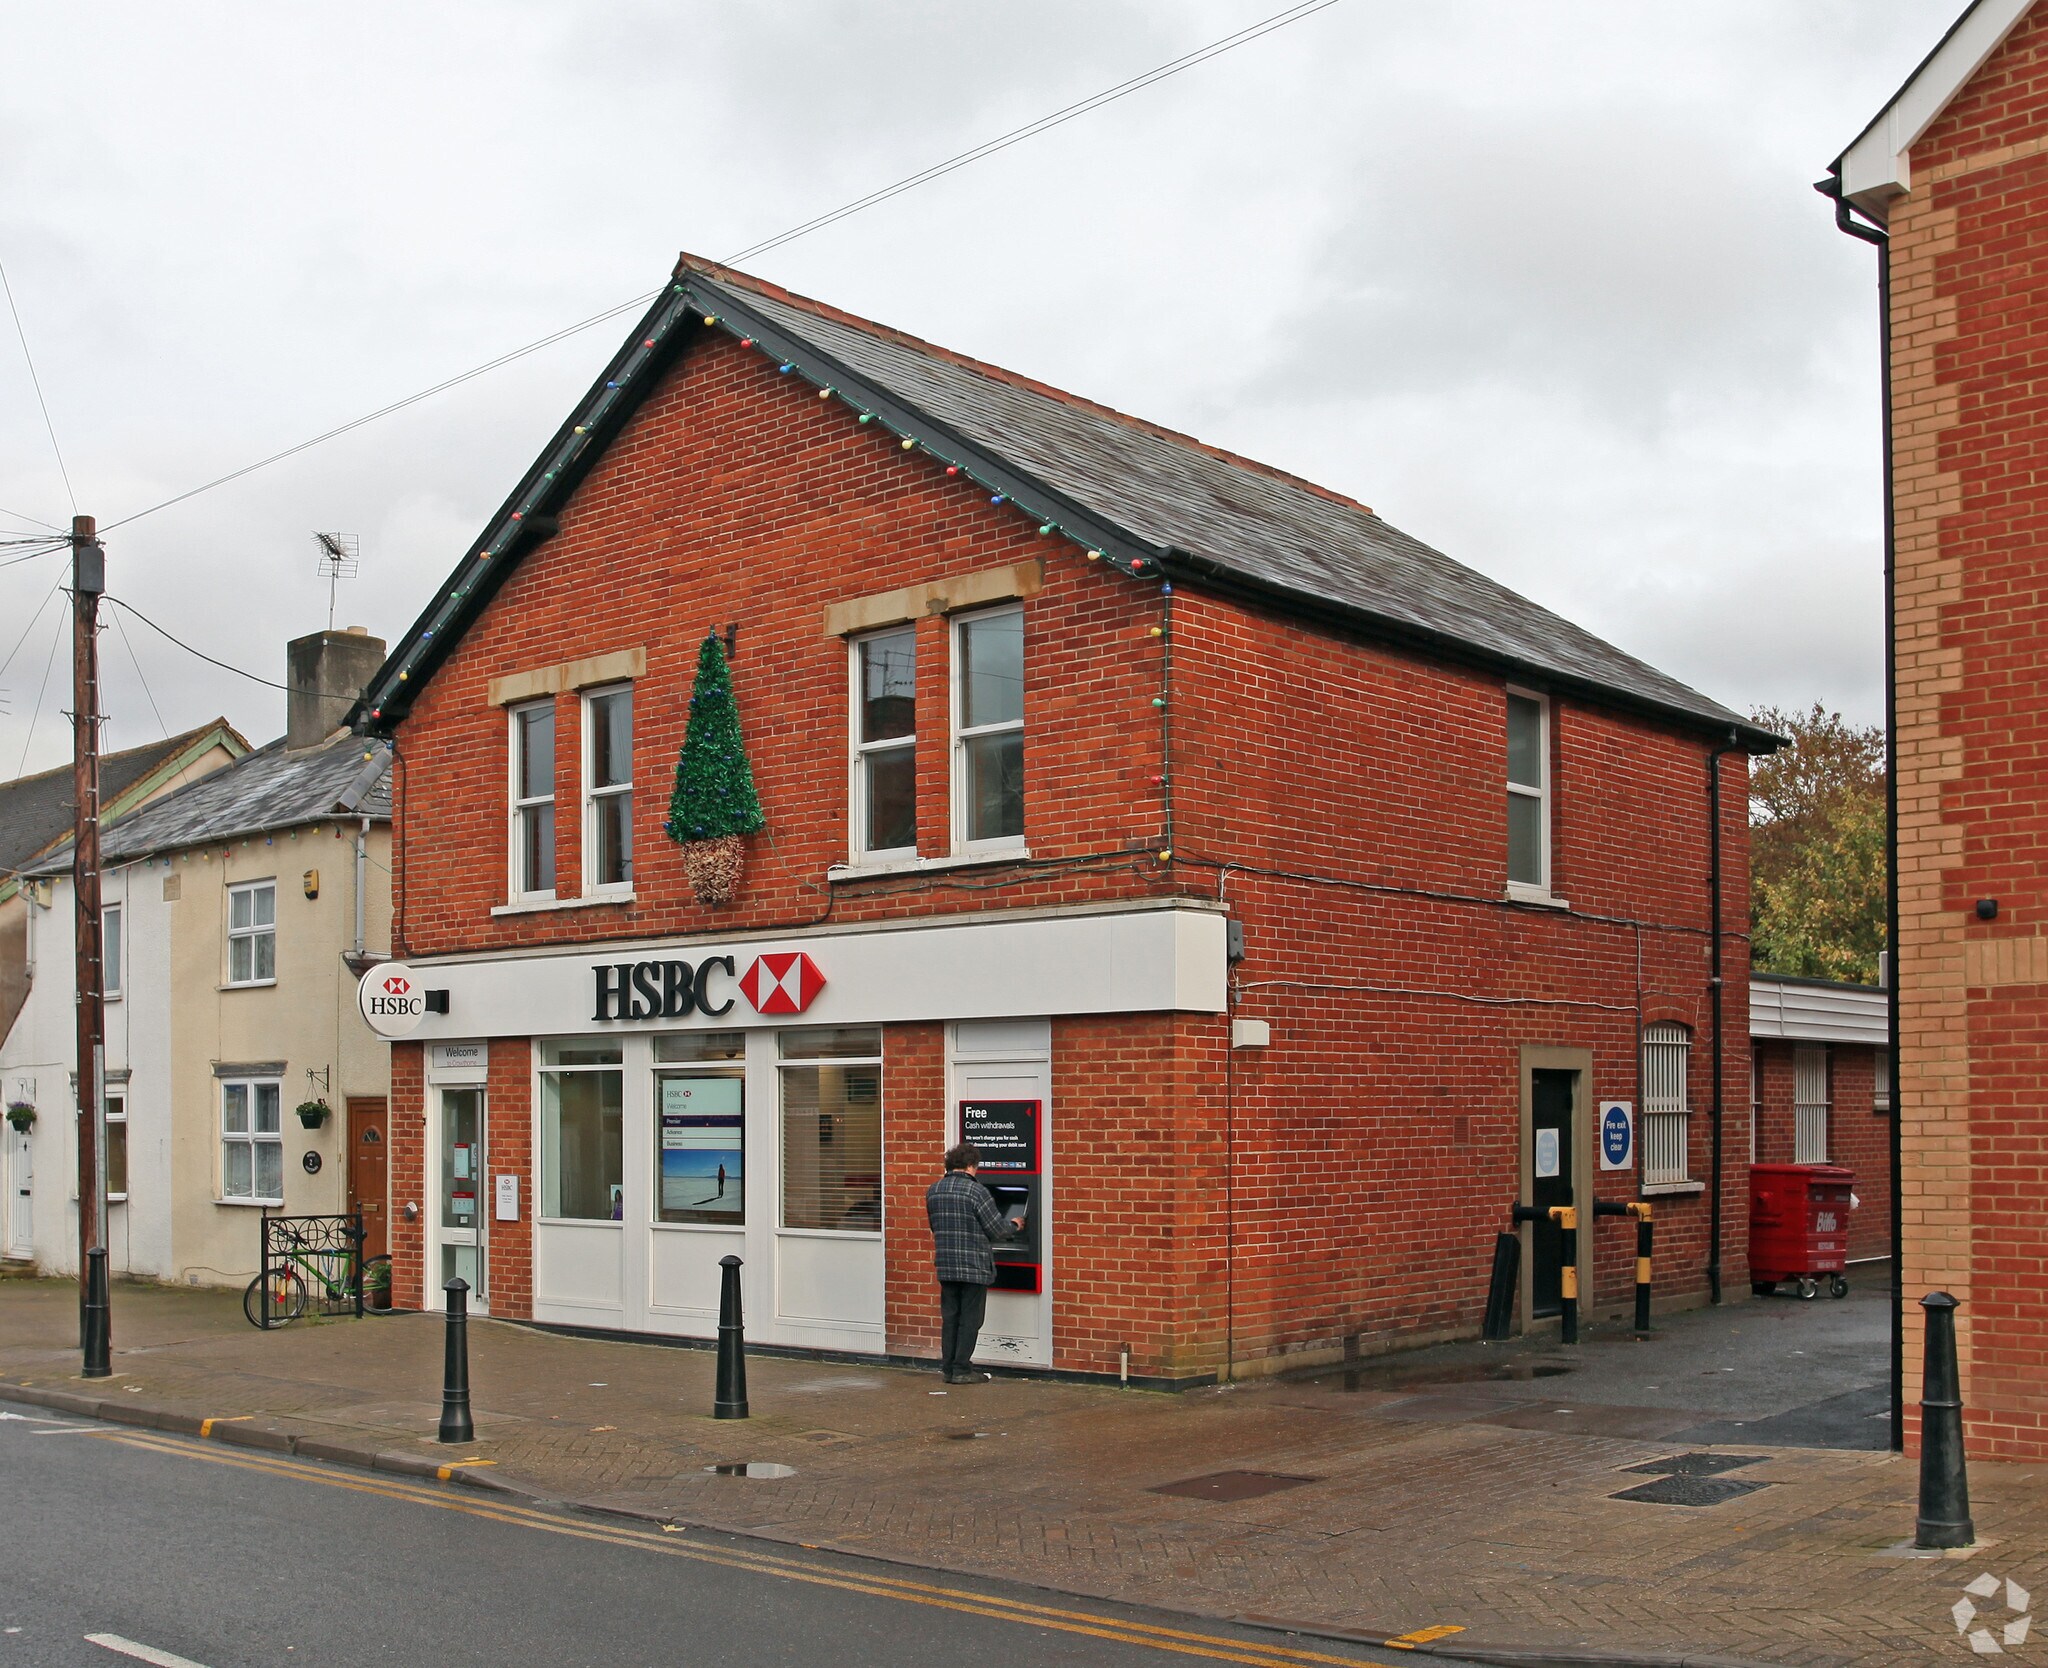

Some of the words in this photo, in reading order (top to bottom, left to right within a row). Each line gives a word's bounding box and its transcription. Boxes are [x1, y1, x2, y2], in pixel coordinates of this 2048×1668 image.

[591, 955, 736, 1021] HSBC
[370, 997, 422, 1016] HSBC
[445, 1047, 478, 1058] Welcome
[666, 1090, 682, 1098] HSBC
[965, 1107, 987, 1118] Free
[965, 1121, 980, 1129] Cash
[981, 1121, 1015, 1129] withdrawals
[1606, 1120, 1616, 1129] Fire
[1617, 1121, 1626, 1129] exit
[1610, 1132, 1623, 1141] keep
[1610, 1143, 1622, 1151] clear
